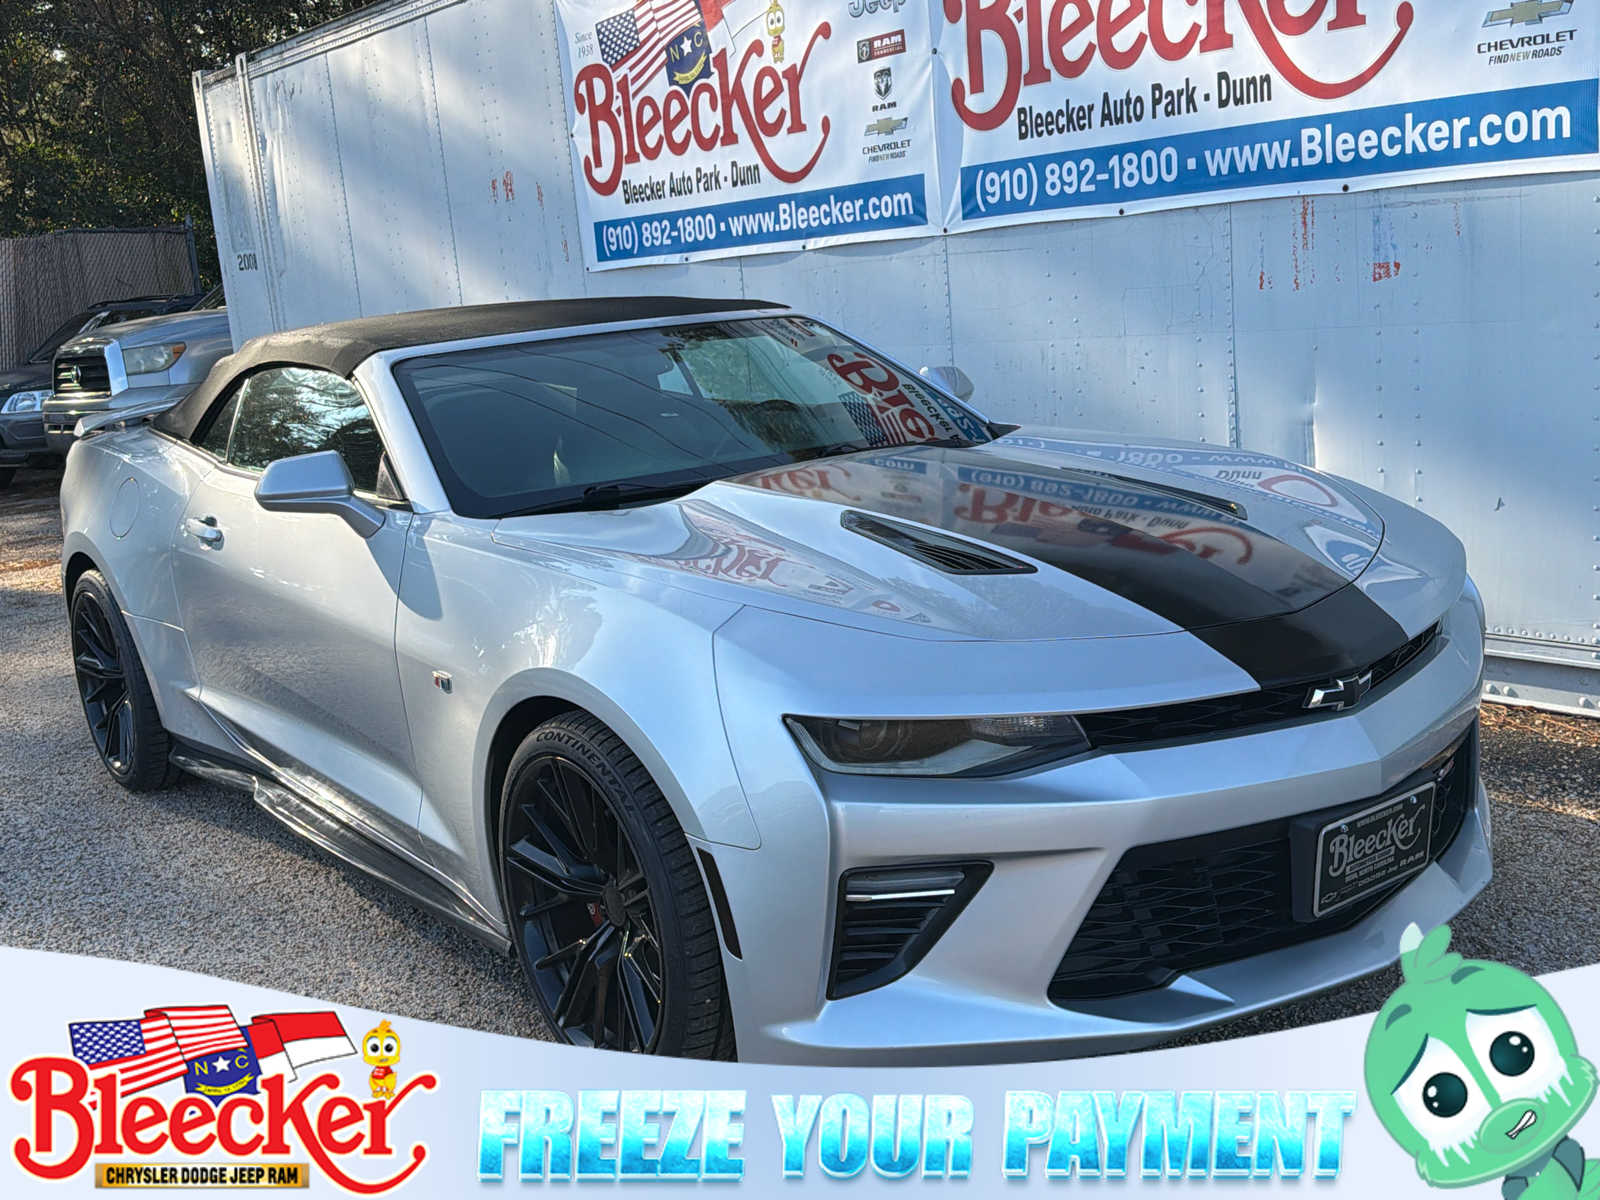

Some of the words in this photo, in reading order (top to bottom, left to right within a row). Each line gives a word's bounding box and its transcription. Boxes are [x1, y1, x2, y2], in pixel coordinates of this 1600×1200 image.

[873, 34, 902, 48] RAM
[1477, 29, 1578, 54] CHEVROLET
[1488, 53, 1510, 65] FIND
[1509, 51, 1532, 62] NEW
[1531, 46, 1564, 59] ROADS
[574, 21, 832, 196] Bleecker
[872, 101, 897, 112] RAM
[1017, 98, 1095, 141] Bleecker
[1100, 88, 1144, 128] Auto
[1151, 77, 1198, 120] Park
[1217, 70, 1272, 109] Dunn
[862, 139, 912, 155] CHEVROLET
[975, 161, 1038, 212] (910)
[1045, 146, 1178, 197] 892-1800
[1204, 104, 1571, 177] www.Bleecker.com
[622, 175, 666, 205] Bleecker
[669, 170, 693, 198] Auto
[696, 164, 722, 193] Park
[731, 160, 761, 188] Dunn
[602, 220, 639, 257] (910)
[641, 213, 717, 248] 892-1800
[728, 191, 914, 238] www.Bleecker.com
